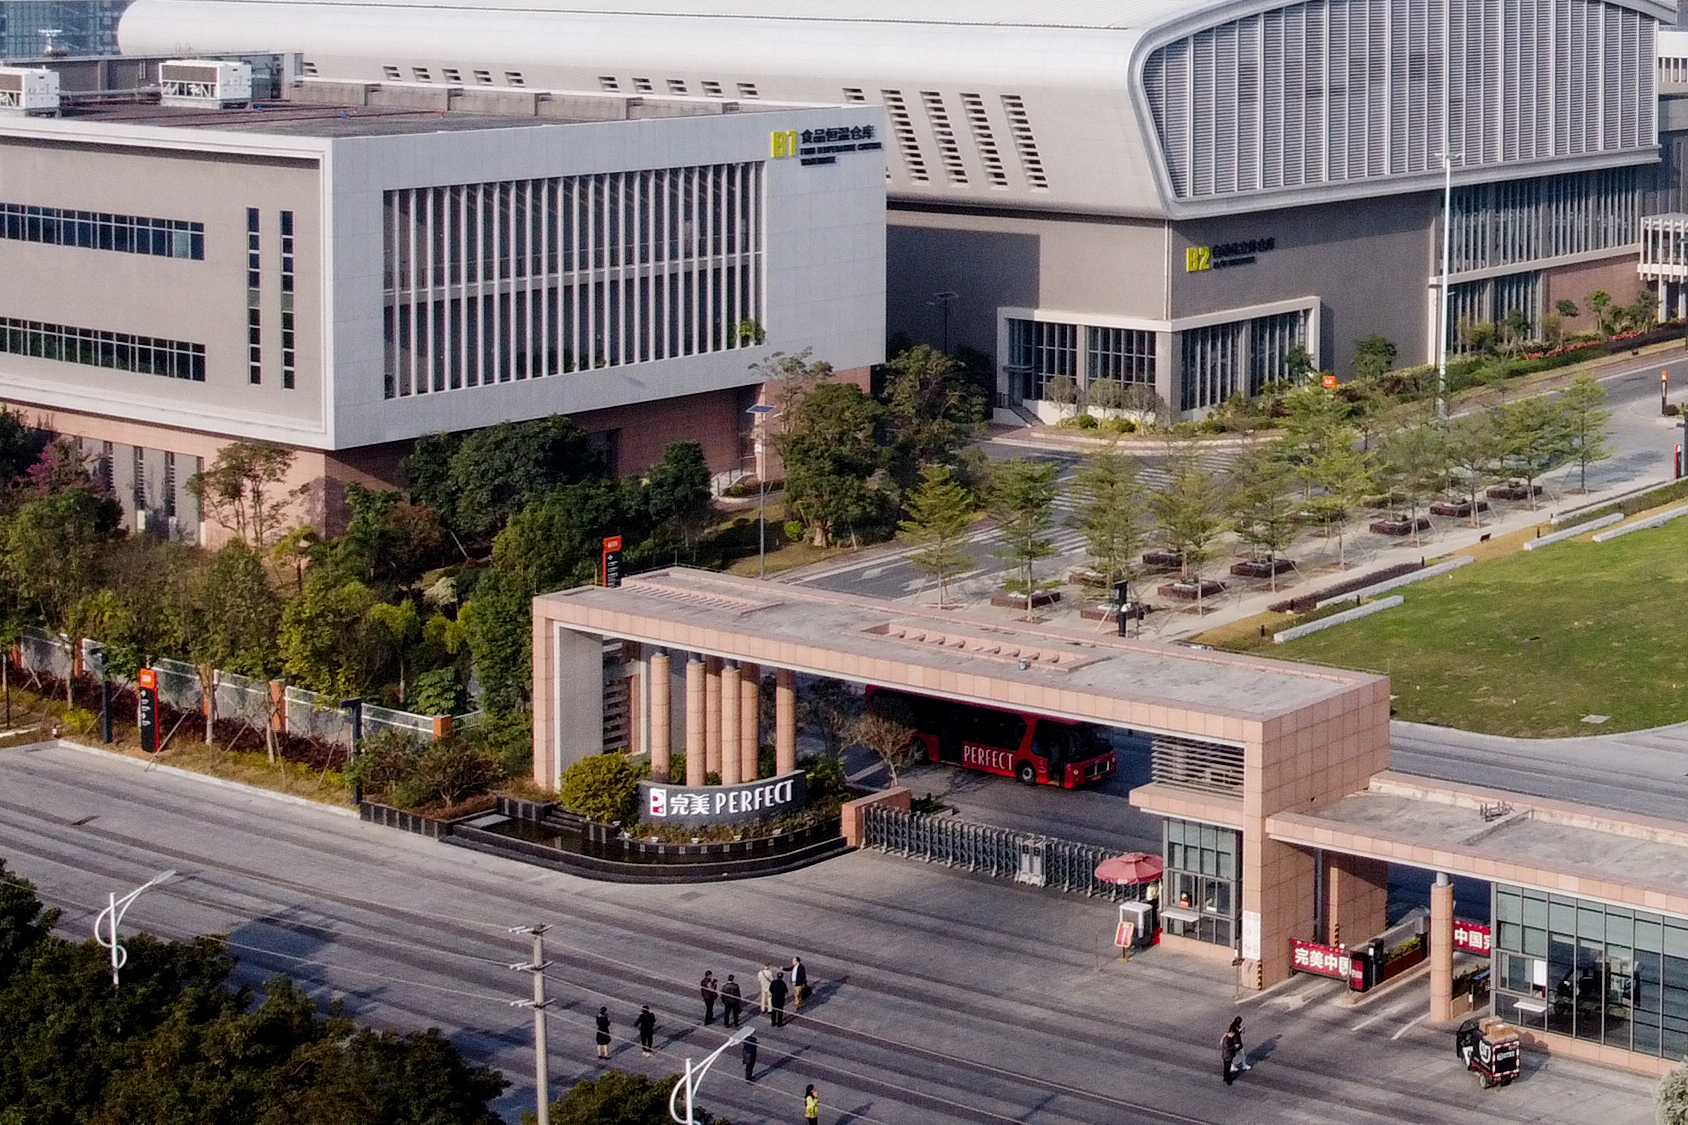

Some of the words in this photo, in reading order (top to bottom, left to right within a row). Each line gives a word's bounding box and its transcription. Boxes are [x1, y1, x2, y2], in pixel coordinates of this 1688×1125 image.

[771, 130, 796, 158] B1
[1185, 246, 1210, 272] B2
[964, 745, 1013, 771] PERFECT
[670, 793, 710, 815] 完美
[715, 780, 794, 814] PERFECT
